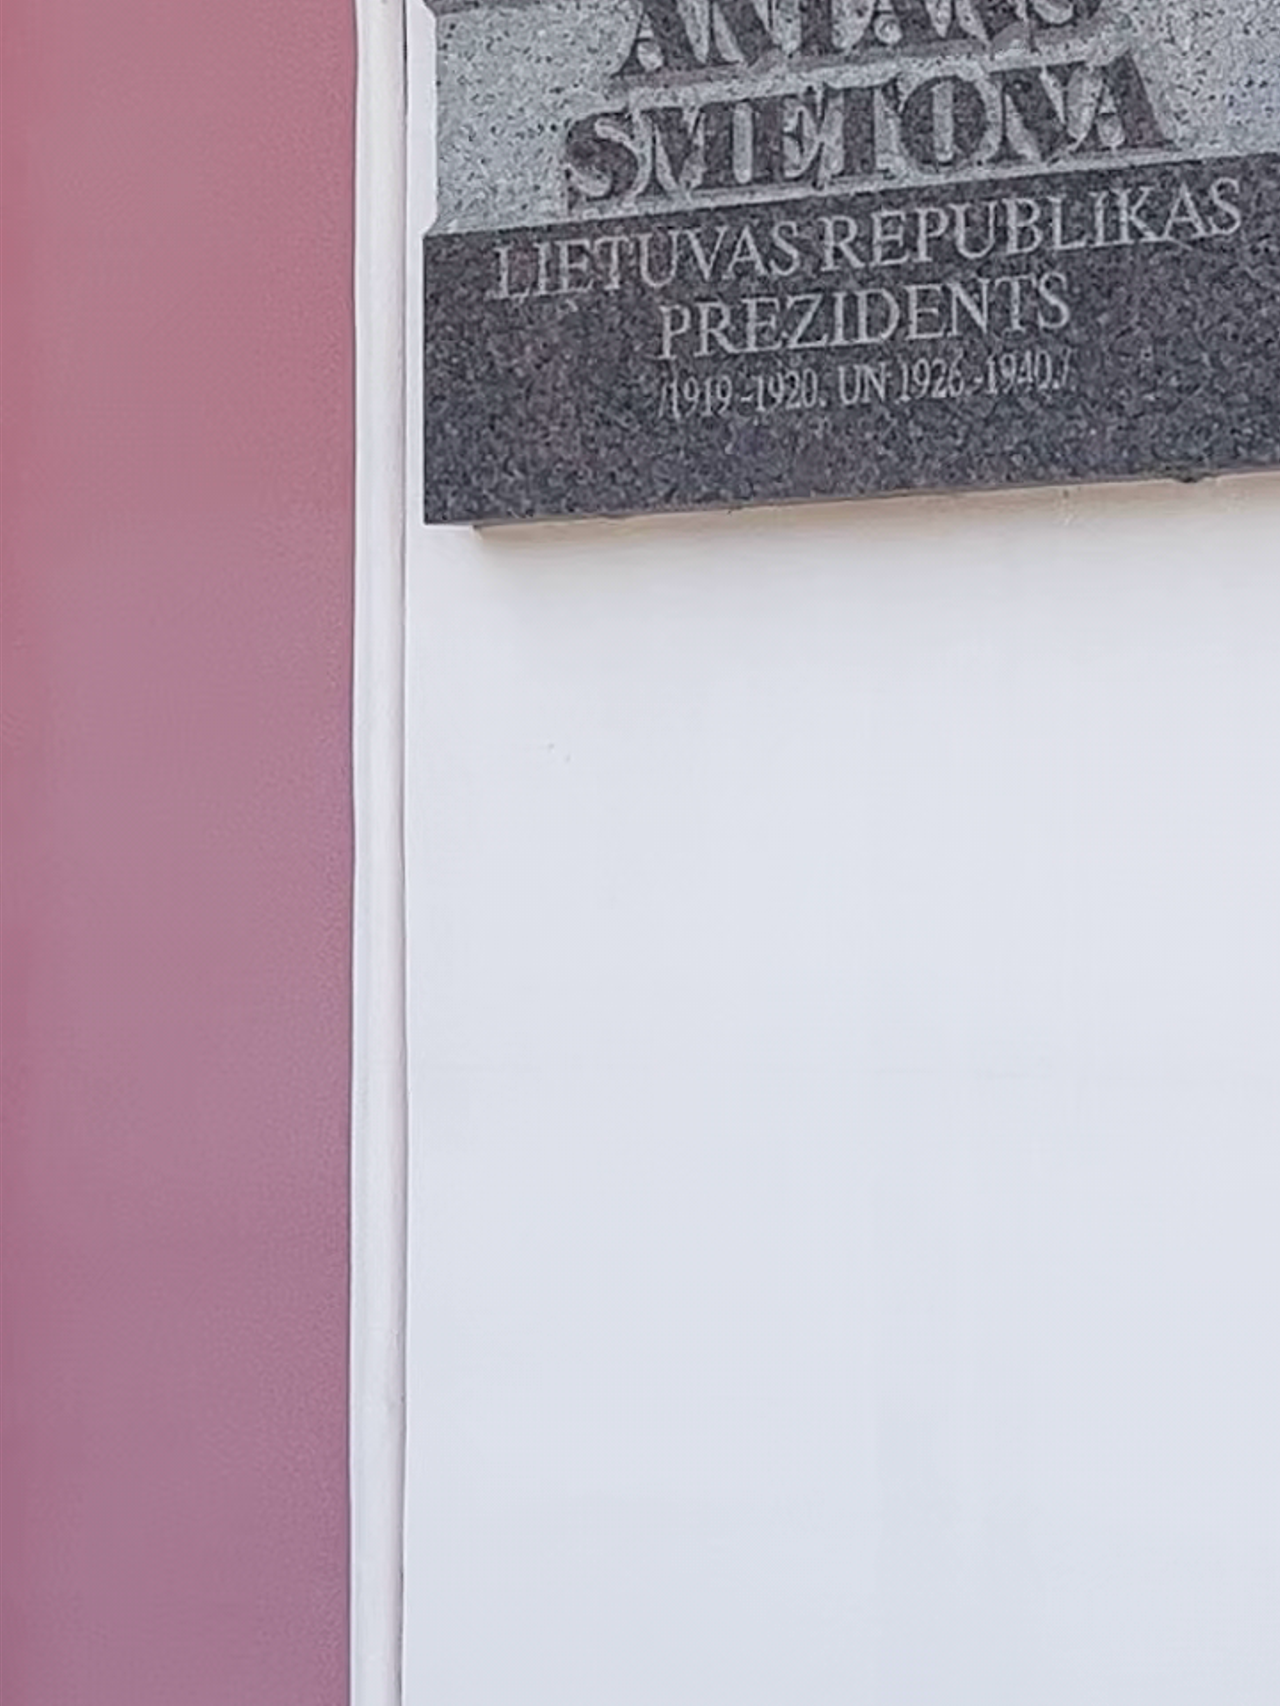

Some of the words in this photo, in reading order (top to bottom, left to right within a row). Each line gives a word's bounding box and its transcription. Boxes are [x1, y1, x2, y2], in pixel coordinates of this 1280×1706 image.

[563, 52, 1182, 204] SMETONA
[492, 220, 801, 300] LIETUVAS
[818, 177, 1242, 272] REPUBLIKAS
[657, 271, 1071, 361] PREZIDENTS
[838, 360, 889, 406] UN
